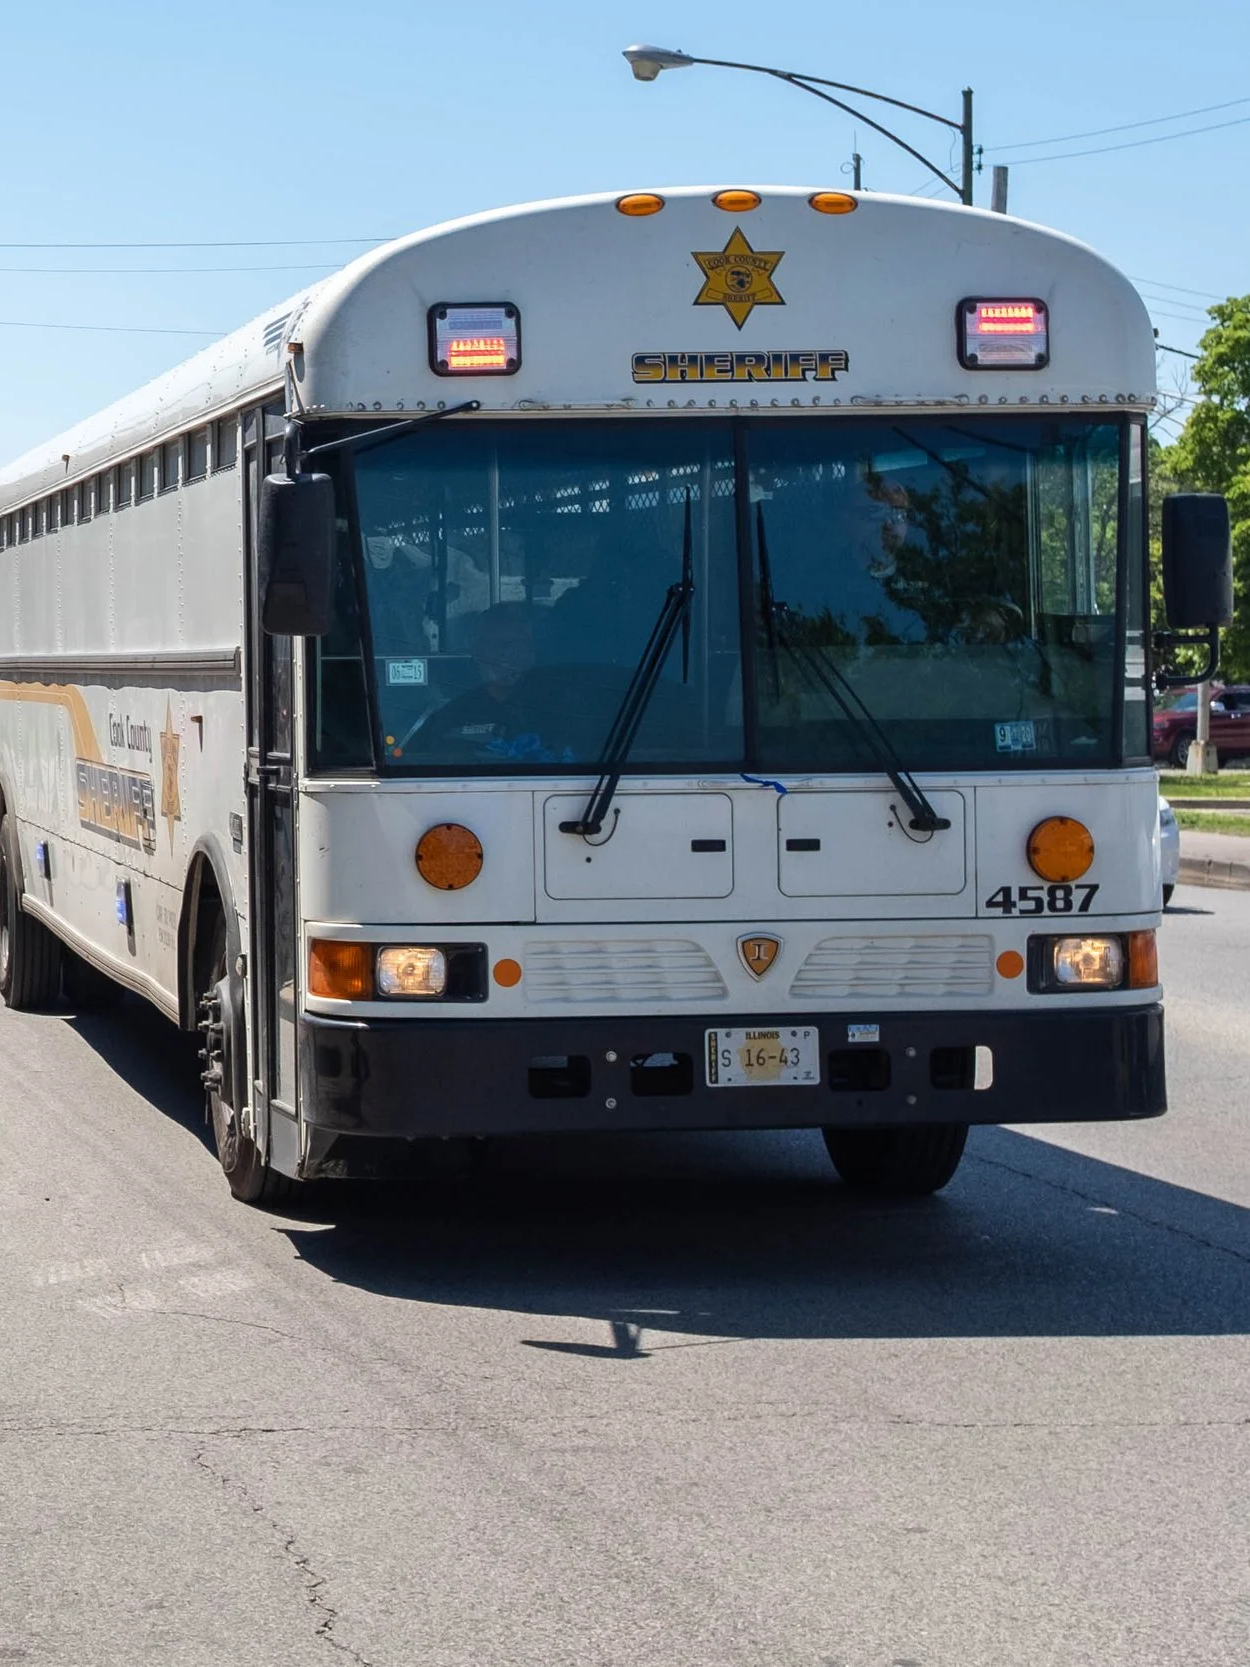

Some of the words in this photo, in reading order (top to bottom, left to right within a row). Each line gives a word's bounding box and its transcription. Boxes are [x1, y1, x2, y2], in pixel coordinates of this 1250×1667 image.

[631, 350, 849, 384] SHERIFF
[109, 713, 125, 748] Cook
[126, 714, 153, 764] County
[998, 726, 1007, 743] 9
[985, 884, 1100, 914] 4587
[745, 1031, 780, 1040] ILLINOIS
[721, 1050, 732, 1068] S
[744, 1047, 800, 1068] 16-43
